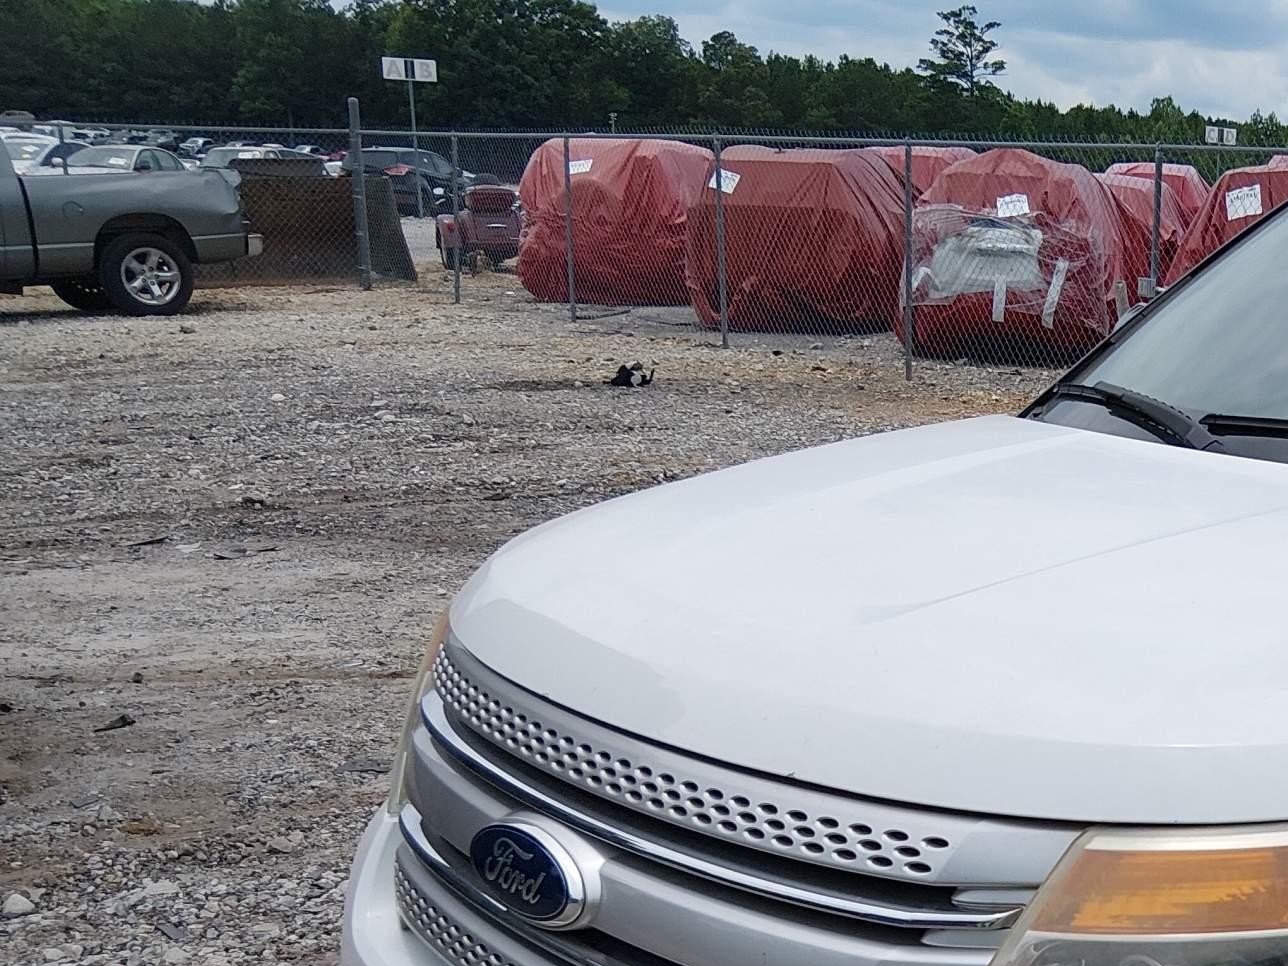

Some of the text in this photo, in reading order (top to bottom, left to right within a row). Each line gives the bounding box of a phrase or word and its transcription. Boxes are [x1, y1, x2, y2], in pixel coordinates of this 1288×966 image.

[386, 60, 433, 79] A B
[486, 837, 547, 904] Ford
